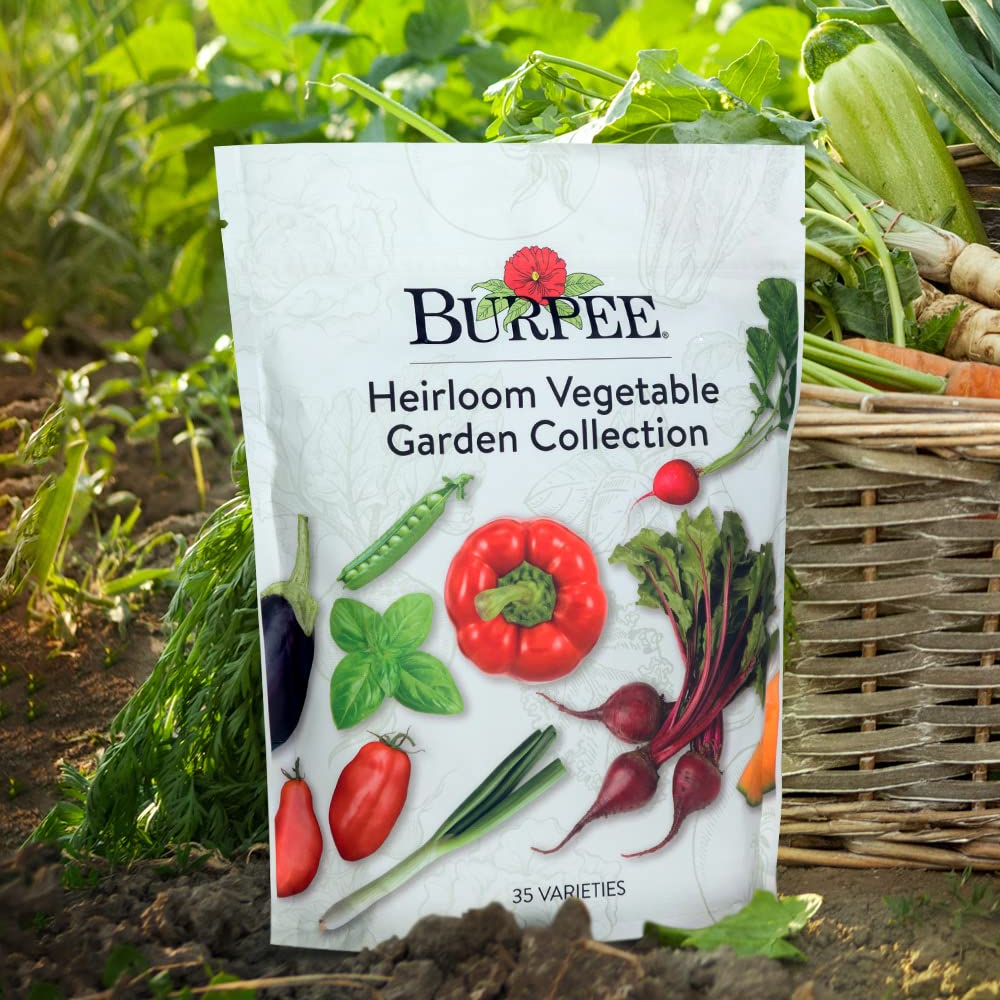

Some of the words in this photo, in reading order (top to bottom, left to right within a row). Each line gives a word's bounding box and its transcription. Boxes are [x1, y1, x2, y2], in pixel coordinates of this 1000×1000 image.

[368, 378, 536, 413] Heirloom
[546, 373, 719, 415] Vegetable
[386, 421, 518, 456] Garden
[530, 416, 709, 452] Collection
[512, 887, 534, 904] 35
[538, 880, 626, 902] VARIETIES
